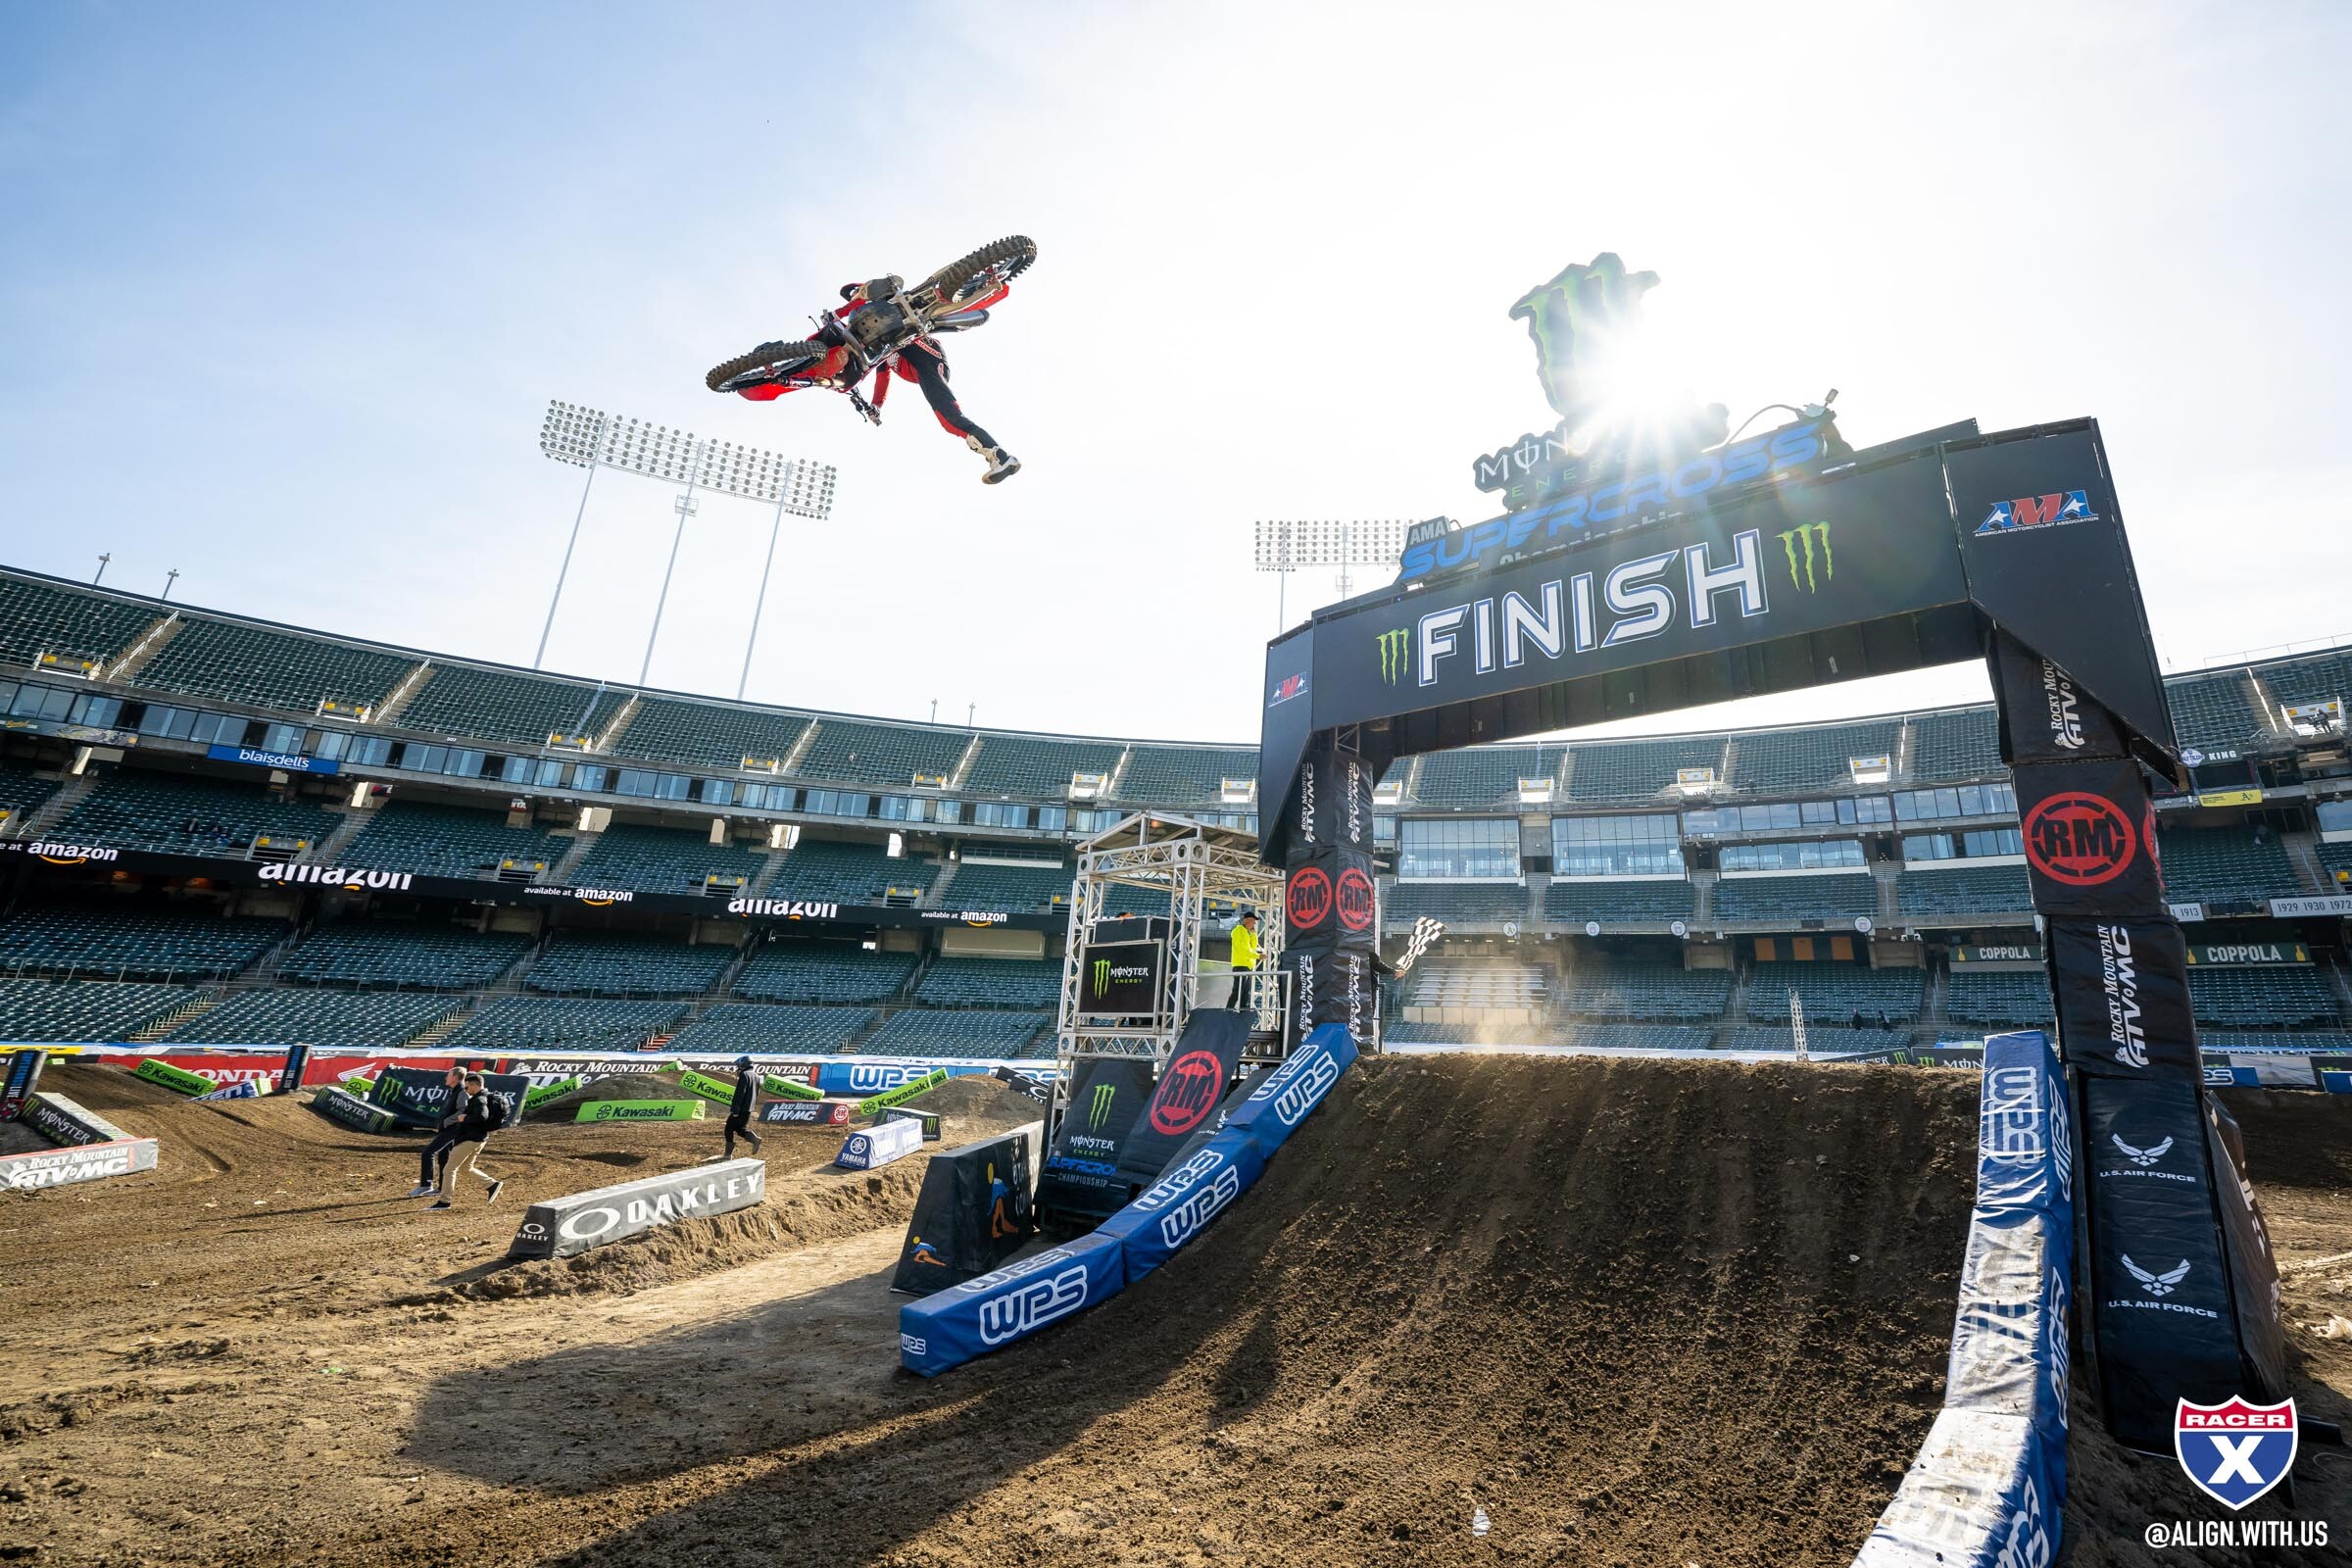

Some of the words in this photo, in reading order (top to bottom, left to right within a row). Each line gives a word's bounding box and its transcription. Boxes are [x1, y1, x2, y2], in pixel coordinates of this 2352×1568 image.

[1400, 422, 1820, 580] SUPERCROSS
[1973, 489, 2098, 533] AMA
[1409, 519, 1446, 546] AMA
[1975, 528, 2007, 538] AMERICAN
[2007, 522, 2055, 533] MOTORCYCLIST
[2056, 516, 2099, 526] ASSOCIATION
[1418, 526, 1770, 688] FINISH
[2047, 692, 2064, 731] ROCKY
[239, 749, 310, 768] blaisdells
[2208, 750, 2237, 760] KING
[27, 842, 119, 861] amazon
[258, 862, 413, 891] amazon
[523, 887, 561, 896] available
[574, 888, 633, 902] amazon
[727, 898, 838, 918] amazon
[921, 910, 950, 919] available
[960, 910, 1007, 922] amazon
[2180, 907, 2199, 918] 1913
[2277, 902, 2299, 912] 1929
[2303, 901, 2326, 911] 1930
[2328, 900, 2352, 910] 1972
[1980, 946, 2031, 959] COPPOLA
[2097, 924, 2120, 998] MOUNTAIN
[2206, 945, 2282, 962] COPPOLA
[1109, 965, 1149, 978] MONSTER
[1298, 1002, 1307, 1031] ROCKY
[2108, 997, 2126, 1045] ROCKY
[189, 1068, 285, 1084] ONDA
[534, 1060, 581, 1073] ROCKY
[584, 1061, 662, 1073] MOUNTAIN
[1249, 1044, 1320, 1102] WPS
[152, 1067, 206, 1092] Kawasaki
[1275, 1051, 1340, 1126] WPS
[525, 1083, 576, 1108] awasaki
[697, 1081, 733, 1102] Kawas
[775, 1084, 820, 1101] Kawasaki
[878, 1081, 931, 1107] Kawasaki
[328, 1095, 369, 1119] MONSTER
[612, 1105, 675, 1117] Kawasaki
[36, 1107, 91, 1145] MONSTER
[1069, 1134, 1115, 1152] MONSTER
[1073, 1149, 1106, 1157] ENERGY
[29, 1155, 70, 1169] ROCKY
[71, 1147, 128, 1164] MOUNTAIN
[842, 1152, 866, 1165] YAMAHA
[1057, 1173, 1108, 1189] CHAMPIONSHIP
[1133, 1150, 1224, 1212] WPS
[2099, 1169, 2122, 1178] U.S.
[2147, 1171, 2196, 1183] FORCE
[627, 1173, 761, 1224] OAKLEY
[1160, 1164, 1240, 1249] WPS
[516, 1232, 550, 1243] OAKLEY
[979, 1264, 1088, 1346] WPS
[2108, 1299, 2133, 1308] U.S.
[2134, 1300, 2161, 1310] AIR
[2162, 1302, 2219, 1319] FORCE
[901, 1333, 926, 1356] WPS
